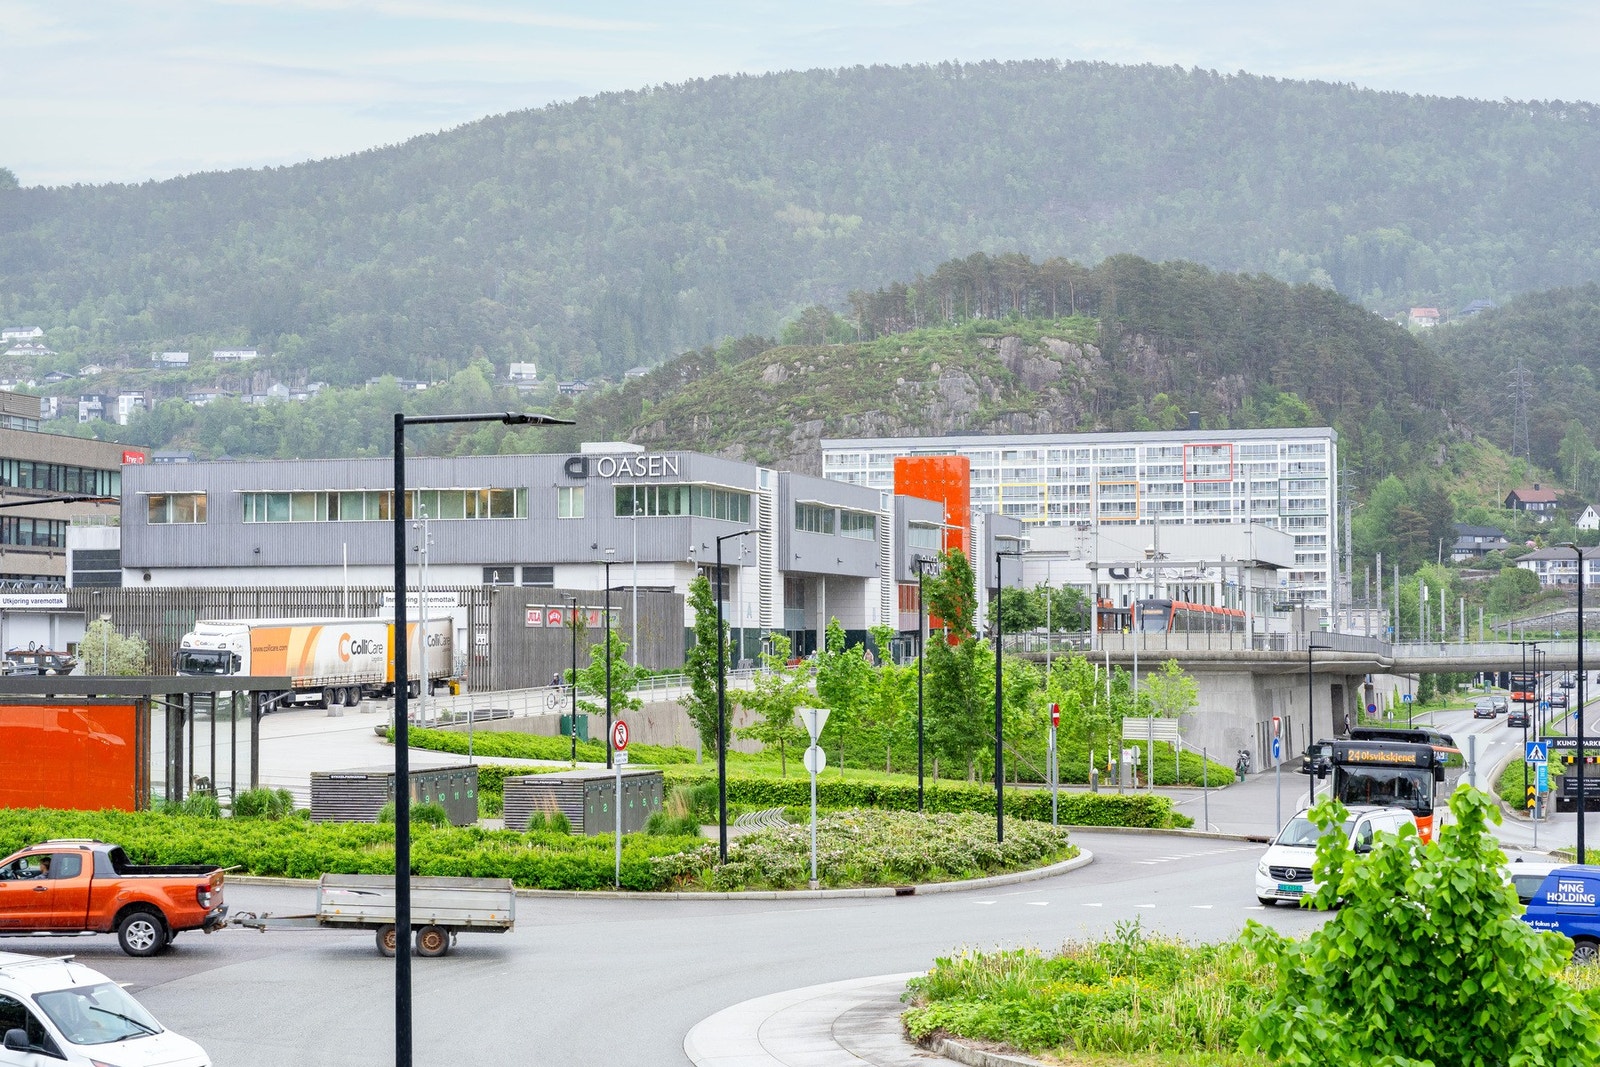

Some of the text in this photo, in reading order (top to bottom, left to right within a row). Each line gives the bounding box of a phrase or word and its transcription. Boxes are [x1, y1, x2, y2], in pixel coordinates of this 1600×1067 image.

[597, 456, 679, 478] OASEN
[428, 633, 451, 647] ColliCare
[351, 639, 384, 655] ColliCare
[1348, 750, 1360, 761] 24
[438, 793, 446, 802] 10
[454, 791, 460, 800] 11
[467, 789, 474, 798] 12
[425, 795, 430, 804] 9
[642, 798, 647, 807] 5
[653, 796, 659, 805] 6
[602, 803, 608, 813] 2
[629, 800, 634, 809] 4
[590, 805, 594, 814] 1
[1558, 883, 1584, 893] MNG
[1546, 892, 1596, 903] HOLDING
